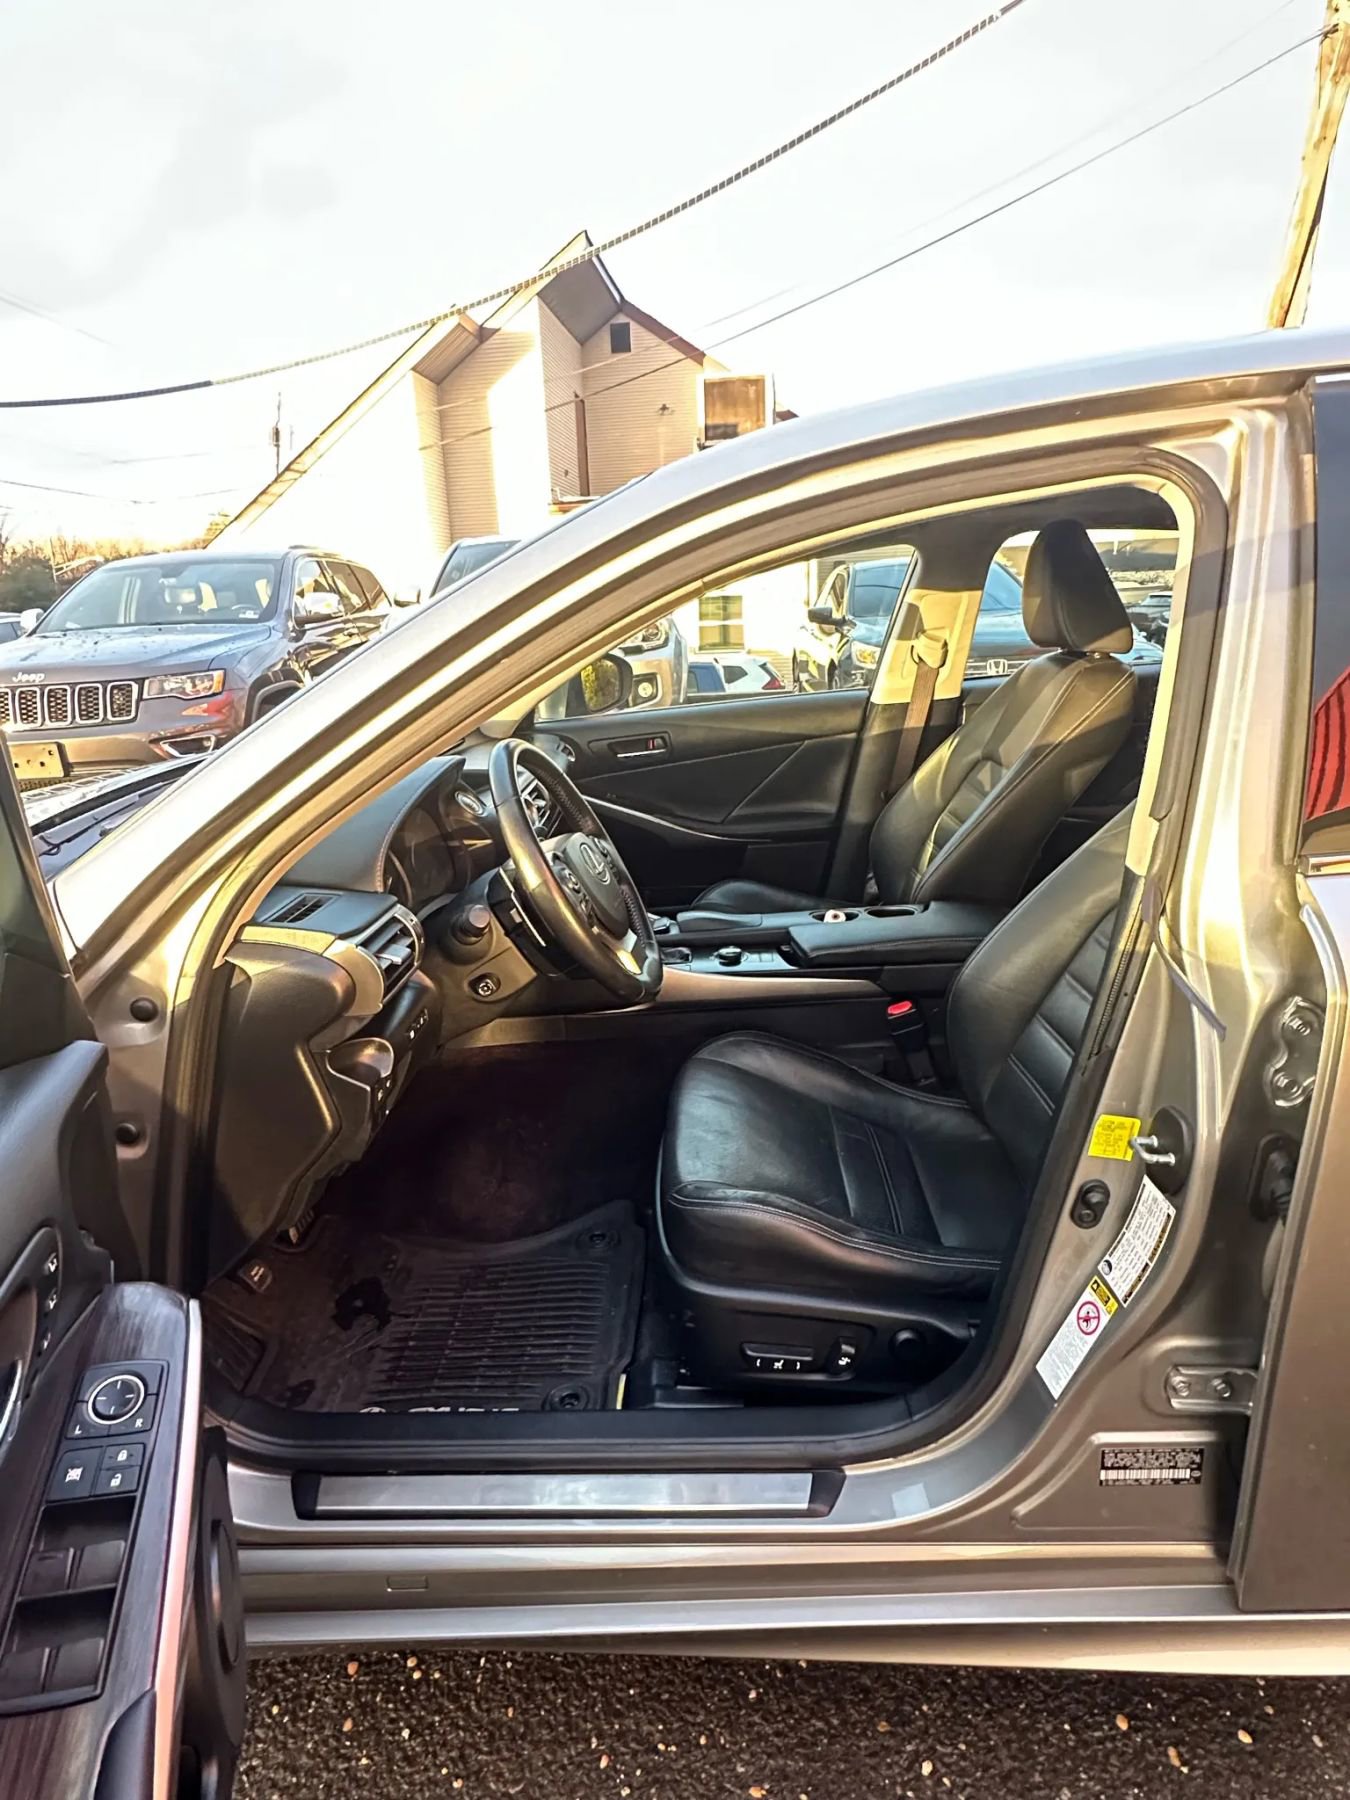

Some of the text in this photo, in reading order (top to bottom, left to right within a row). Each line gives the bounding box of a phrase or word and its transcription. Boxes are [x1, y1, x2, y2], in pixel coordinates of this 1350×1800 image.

[12, 671, 45, 683] Jeep
[135, 1418, 143, 1428] R
[74, 1424, 82, 1435] L
